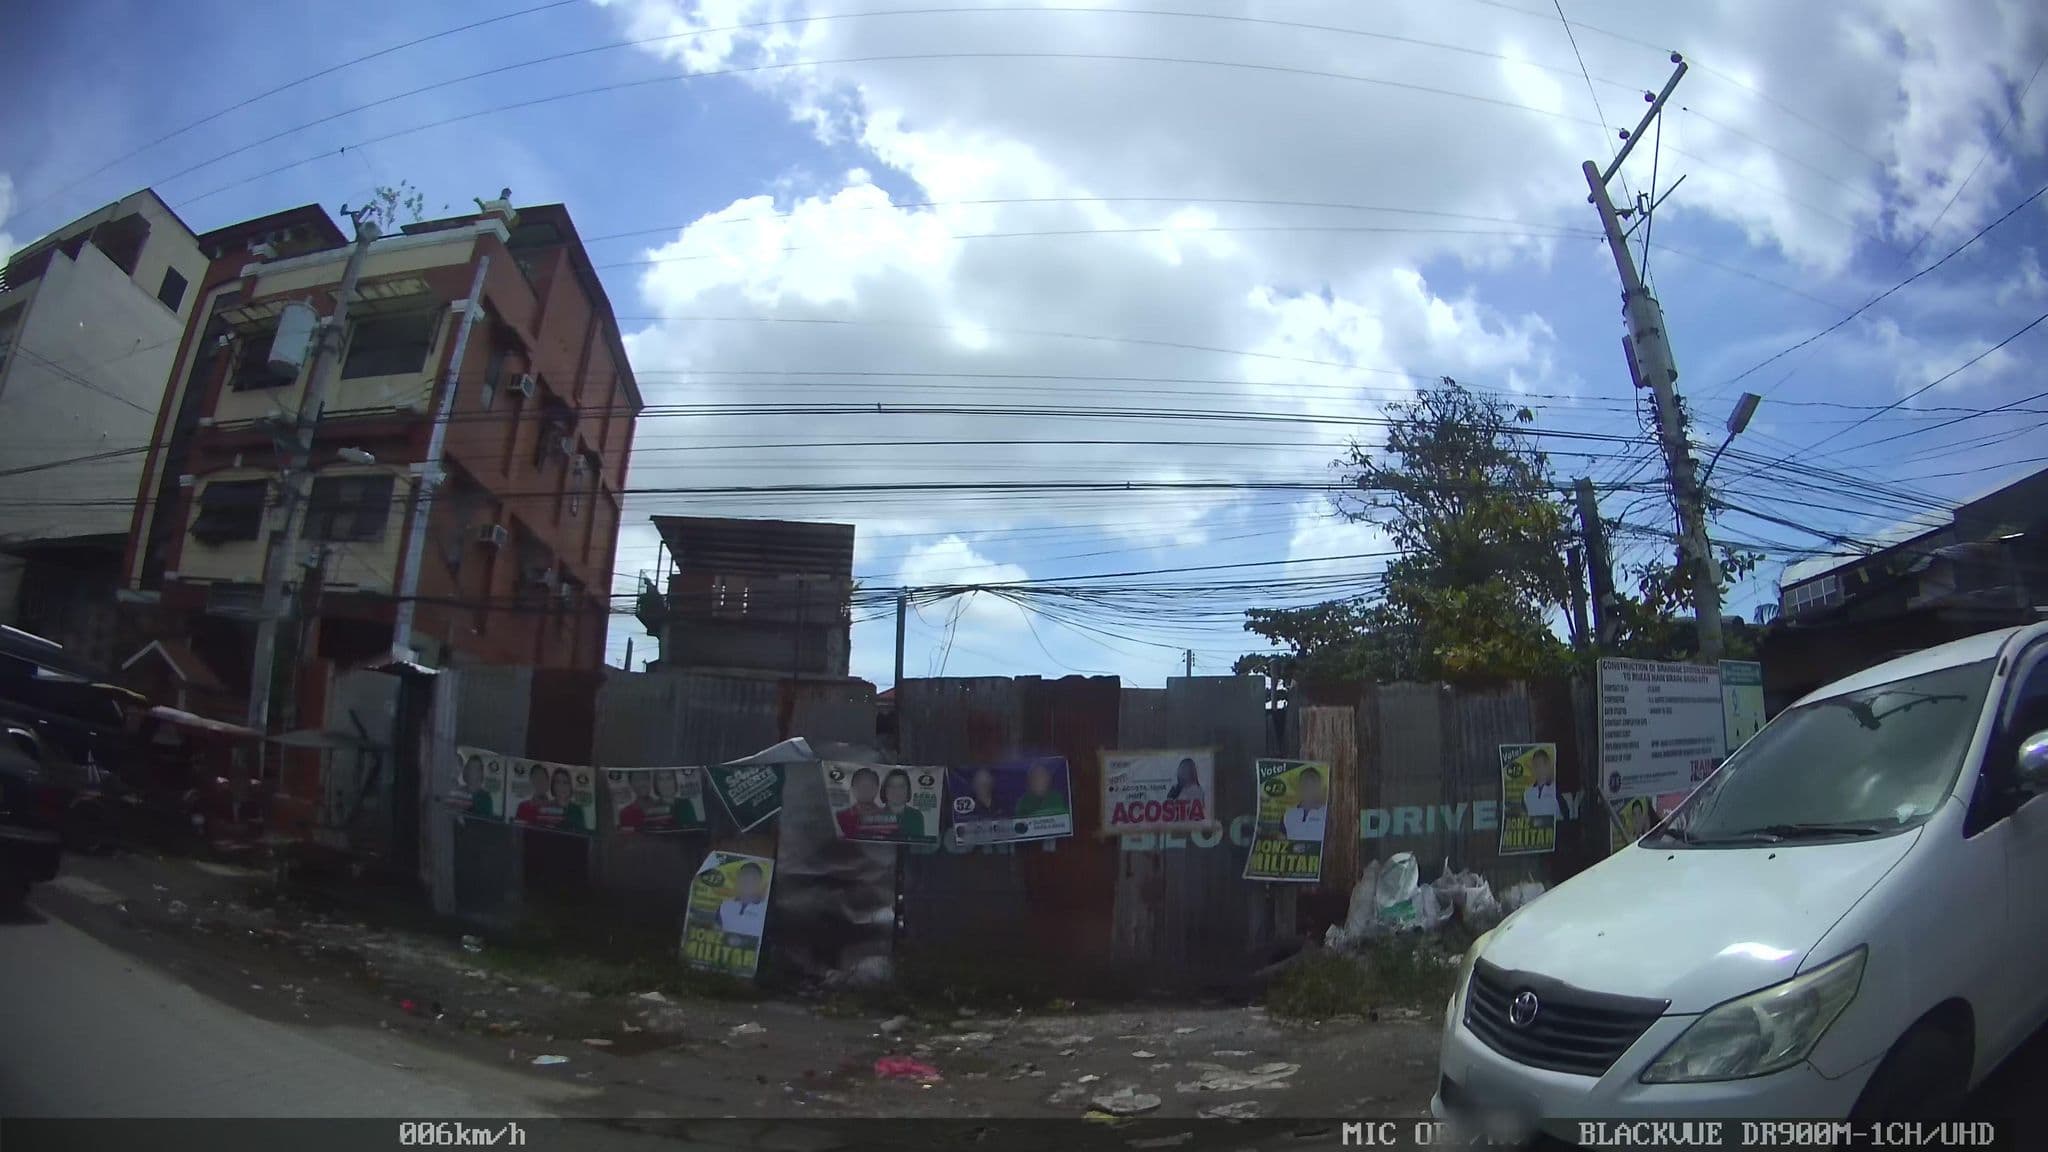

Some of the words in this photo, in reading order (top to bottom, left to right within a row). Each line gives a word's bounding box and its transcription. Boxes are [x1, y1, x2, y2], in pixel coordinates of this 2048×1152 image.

[1260, 763, 1287, 778] Vote!
[956, 799, 971, 811] 52
[1111, 800, 1205, 824] ACOSTA
[1360, 791, 1584, 839] DRIVEY
